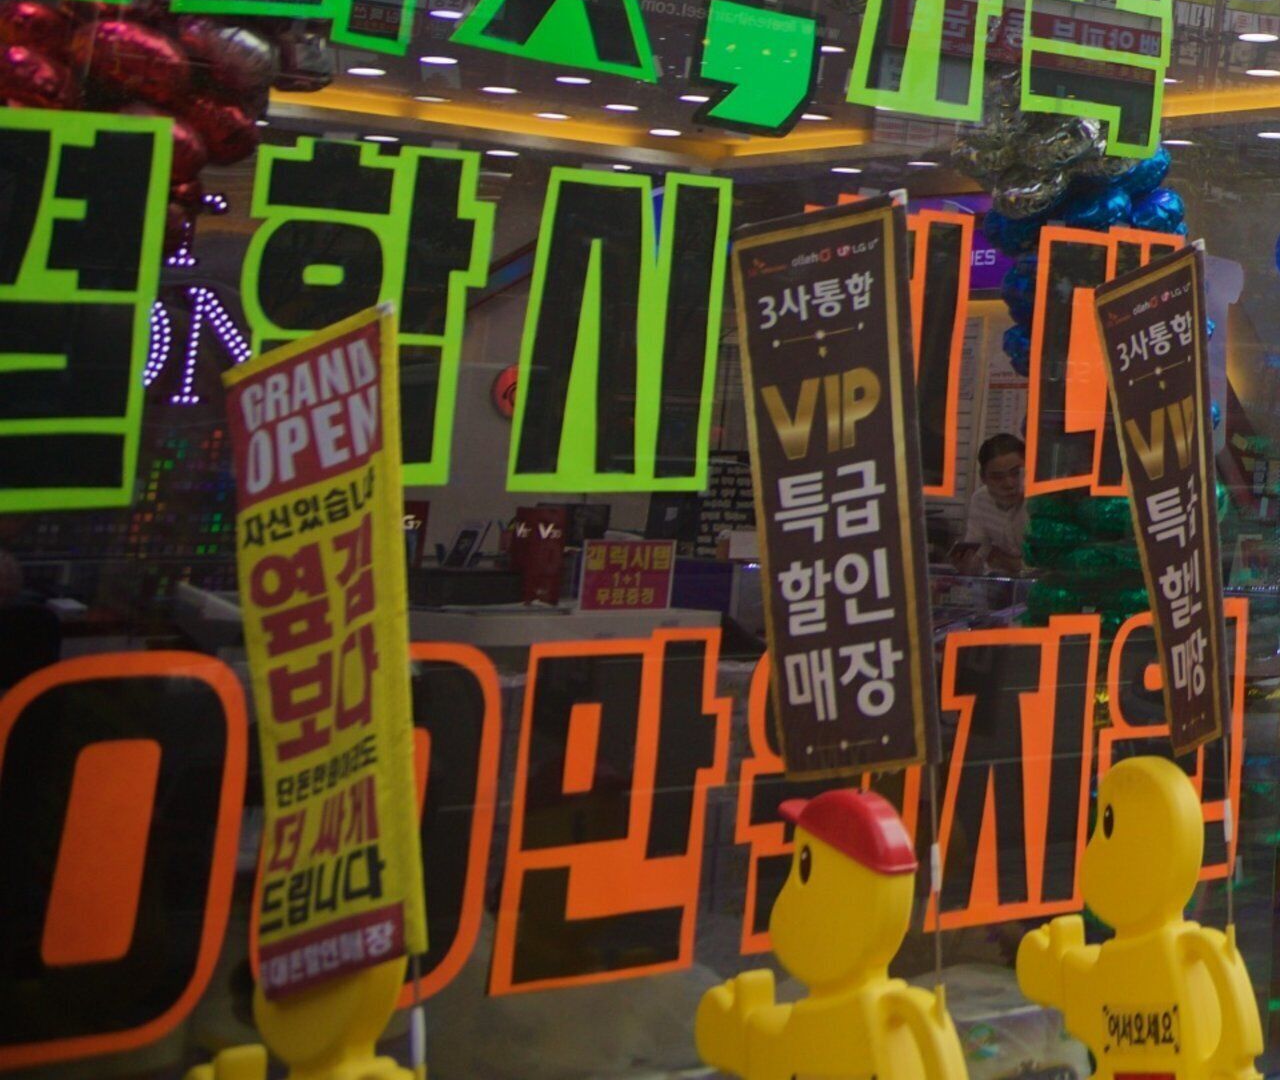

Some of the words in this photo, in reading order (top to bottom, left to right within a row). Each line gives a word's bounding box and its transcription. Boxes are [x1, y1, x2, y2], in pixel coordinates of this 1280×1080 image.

[757, 269, 875, 330] 3사통합
[1115, 310, 1193, 373] 3사통합
[239, 337, 377, 432] GRAND
[760, 366, 882, 460] VIP
[246, 386, 378, 497] OPEN
[774, 459, 886, 542] 특급
[611, 571, 642, 587] 1+1
[779, 547, 895, 636] 할인
[268, 624, 382, 763] 보다
[784, 640, 904, 721] 매장
[269, 809, 308, 875] 더
[310, 773, 380, 861] 싸게
[260, 844, 386, 936] 드립니다
[1105, 1009, 1177, 1046] 어서오세요
